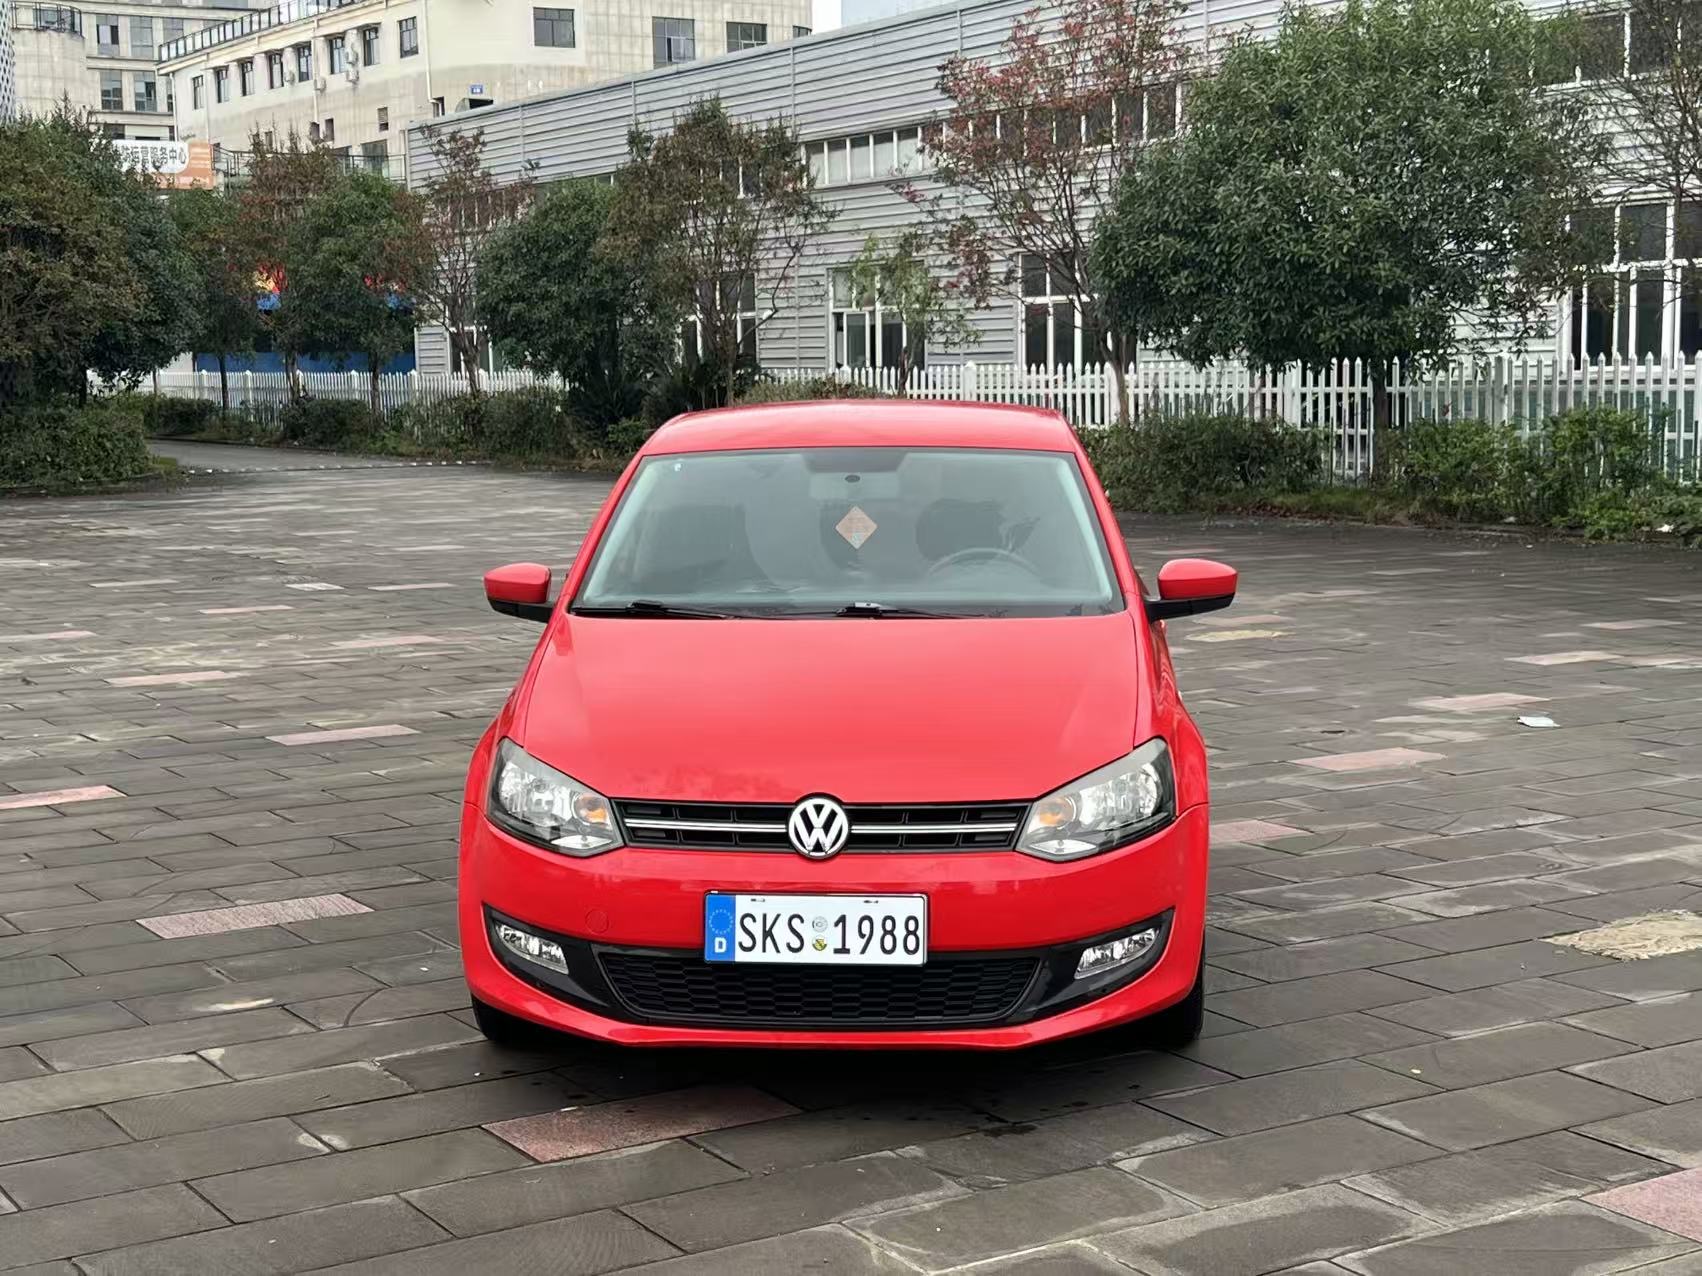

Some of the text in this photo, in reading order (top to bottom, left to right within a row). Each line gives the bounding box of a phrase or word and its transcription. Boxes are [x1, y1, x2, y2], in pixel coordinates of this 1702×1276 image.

[789, 798, 849, 857] VW
[714, 937, 728, 953] D
[738, 912, 920, 955] SKS 1988
